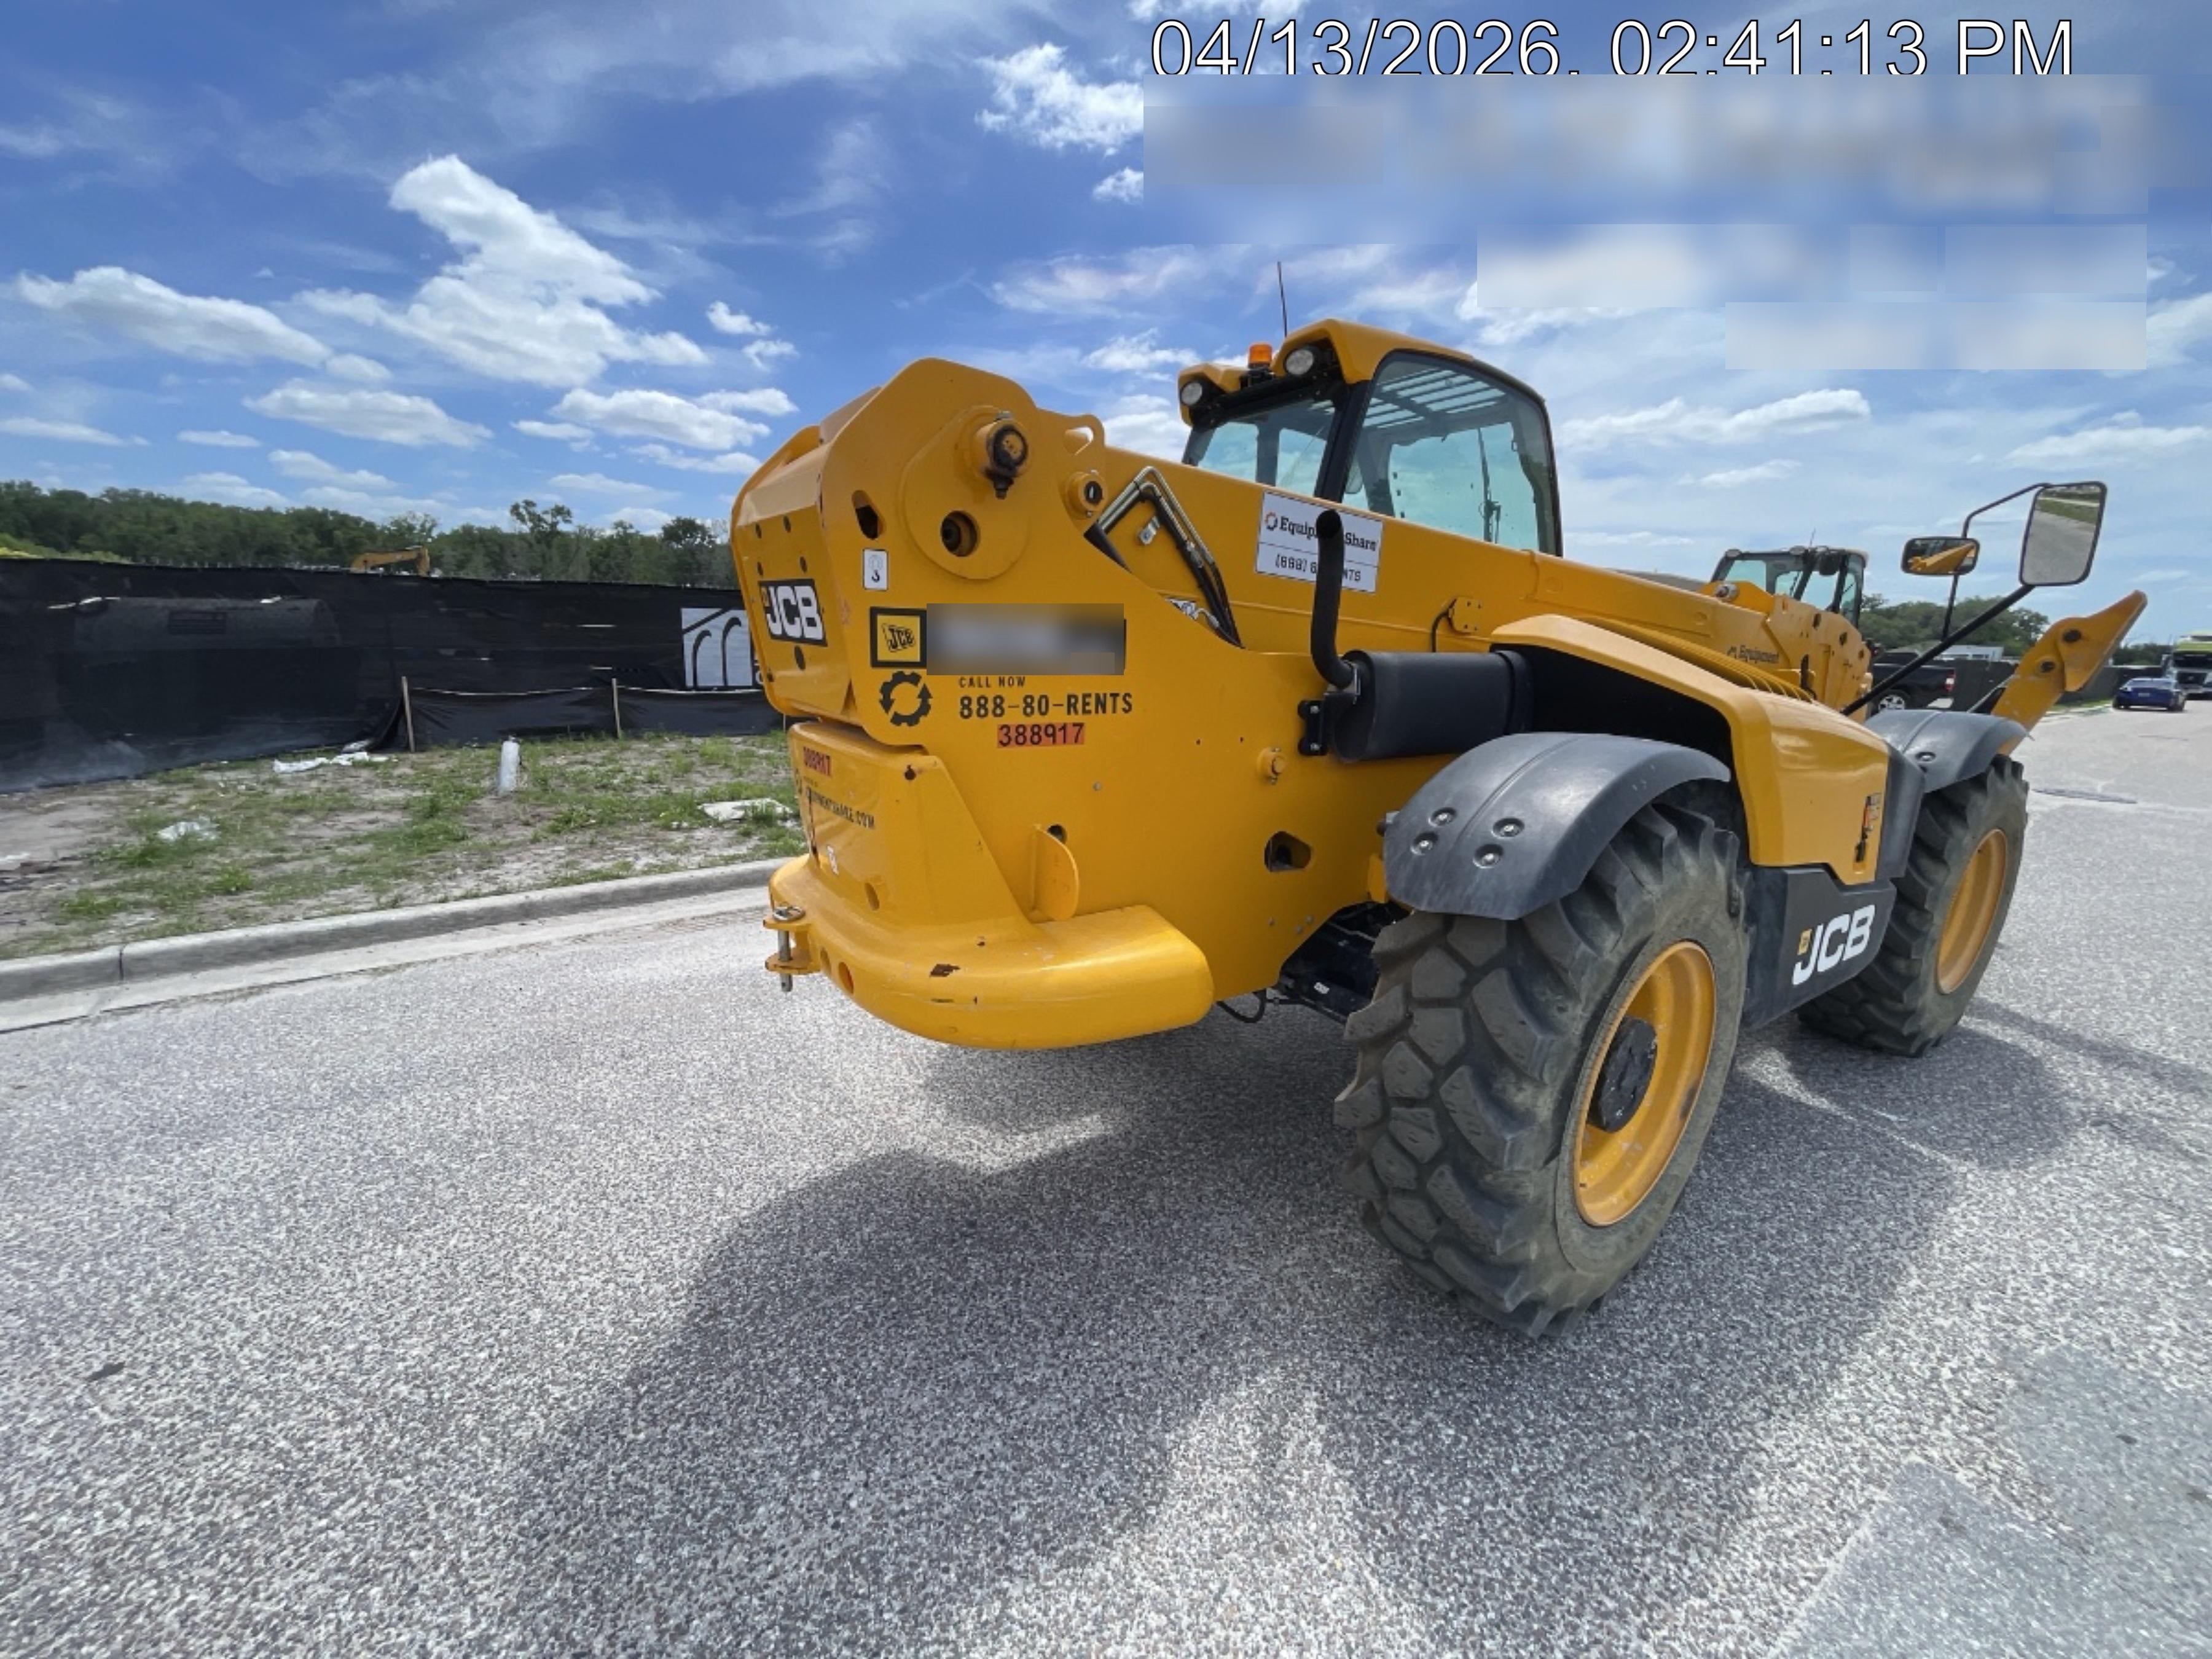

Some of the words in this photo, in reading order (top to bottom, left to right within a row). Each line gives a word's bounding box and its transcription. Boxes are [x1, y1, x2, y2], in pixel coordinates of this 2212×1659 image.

[1280, 516, 1377, 551] EquipShare
[766, 585, 823, 640] JCB
[887, 625, 915, 652] JCB
[959, 677, 992, 688] CALL
[998, 676, 1026, 688] NOW
[959, 692, 1133, 719] 888-80-RENTS
[998, 723, 1084, 747] 388917
[1792, 904, 1876, 985] JCB
